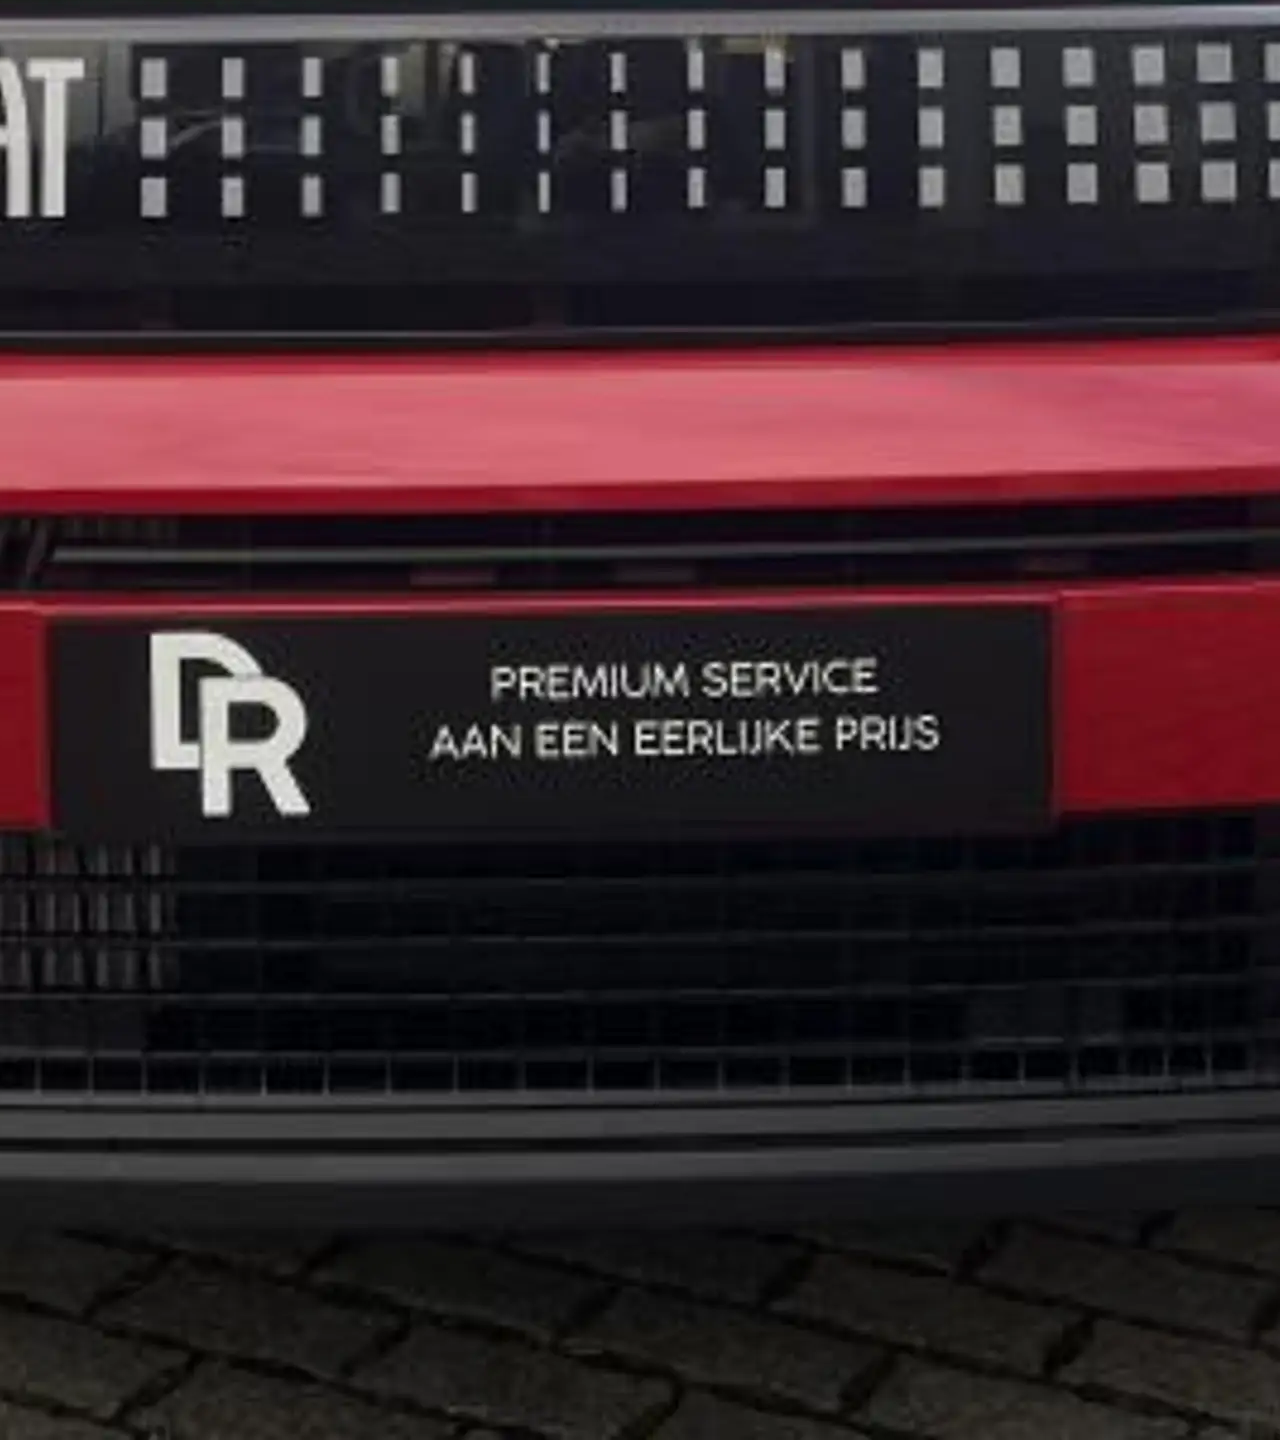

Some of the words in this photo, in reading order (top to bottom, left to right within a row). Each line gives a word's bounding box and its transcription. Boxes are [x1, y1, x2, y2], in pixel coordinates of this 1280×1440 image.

[490, 661, 691, 701] PREMIUM
[701, 656, 880, 699] SERVICE
[149, 631, 311, 817] DR
[428, 722, 523, 761] AAN
[534, 720, 620, 759] EEN
[633, 716, 822, 757] EERLIJKE
[834, 713, 941, 752] PRIJS
